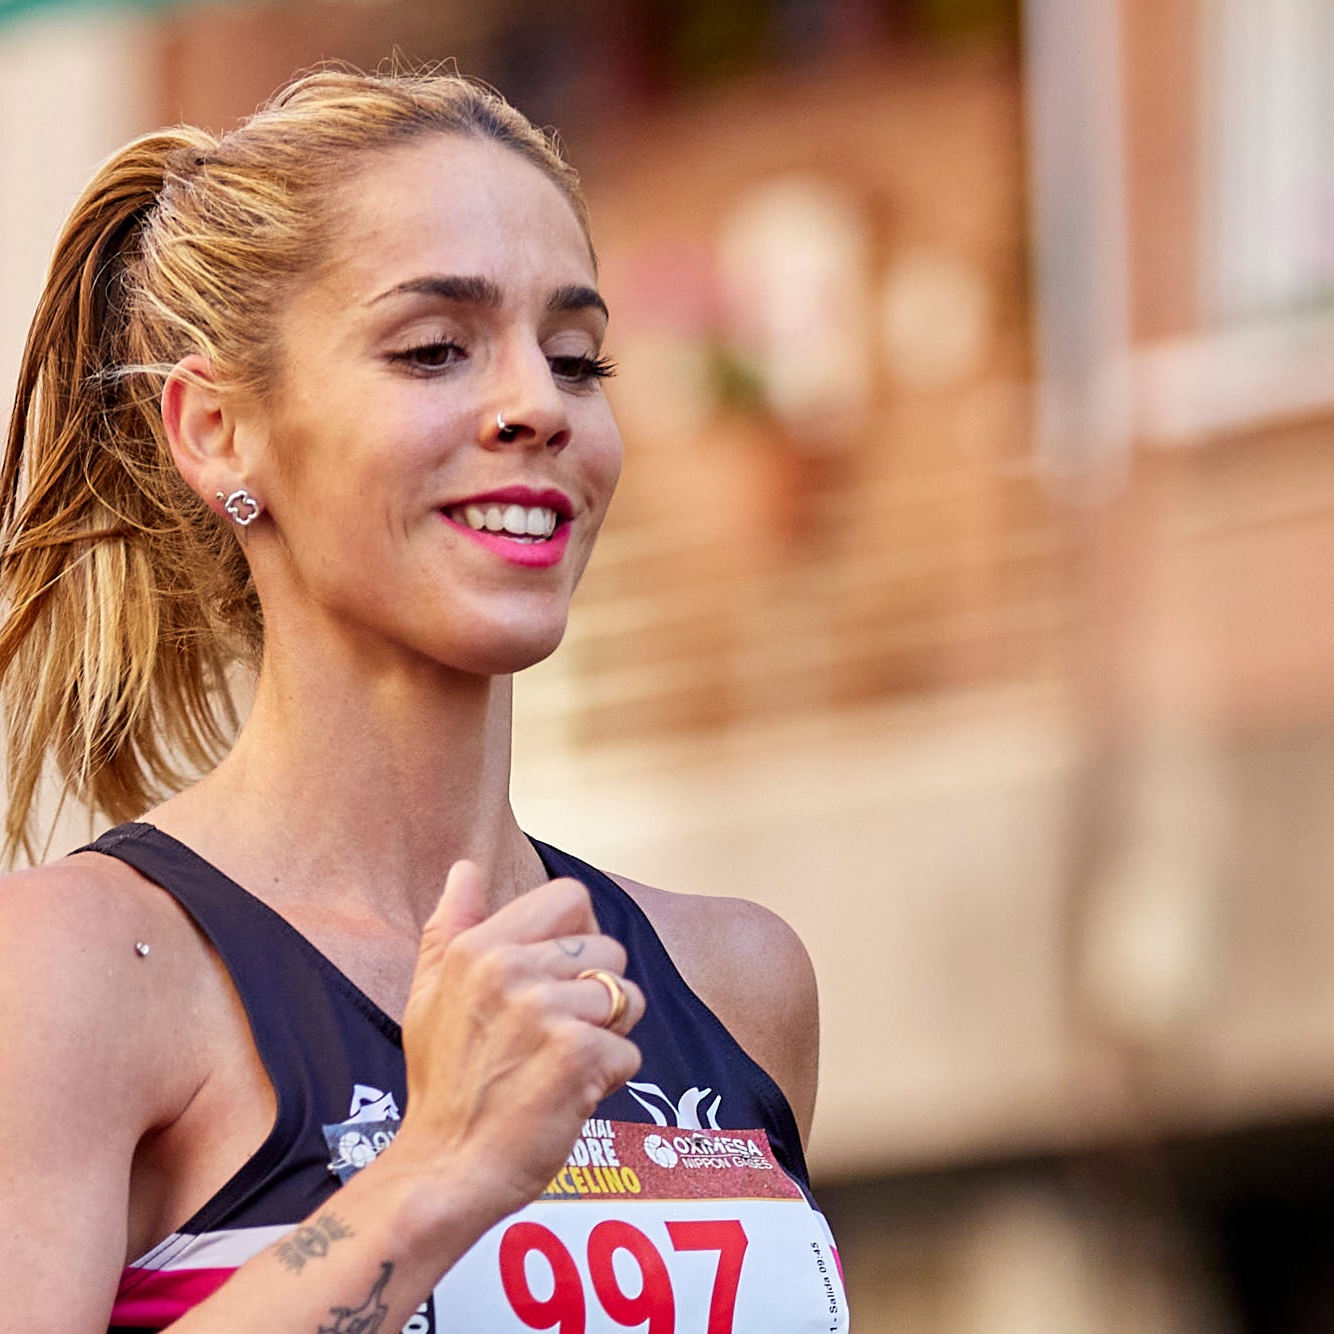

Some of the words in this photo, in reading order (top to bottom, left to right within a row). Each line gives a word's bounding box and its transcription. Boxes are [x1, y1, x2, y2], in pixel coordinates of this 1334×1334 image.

[673, 1136, 763, 1157] OXIMESA
[682, 1157, 731, 1169] NIPPON
[811, 1242, 827, 1273] 09:45
[824, 1277, 838, 1314] Salida
